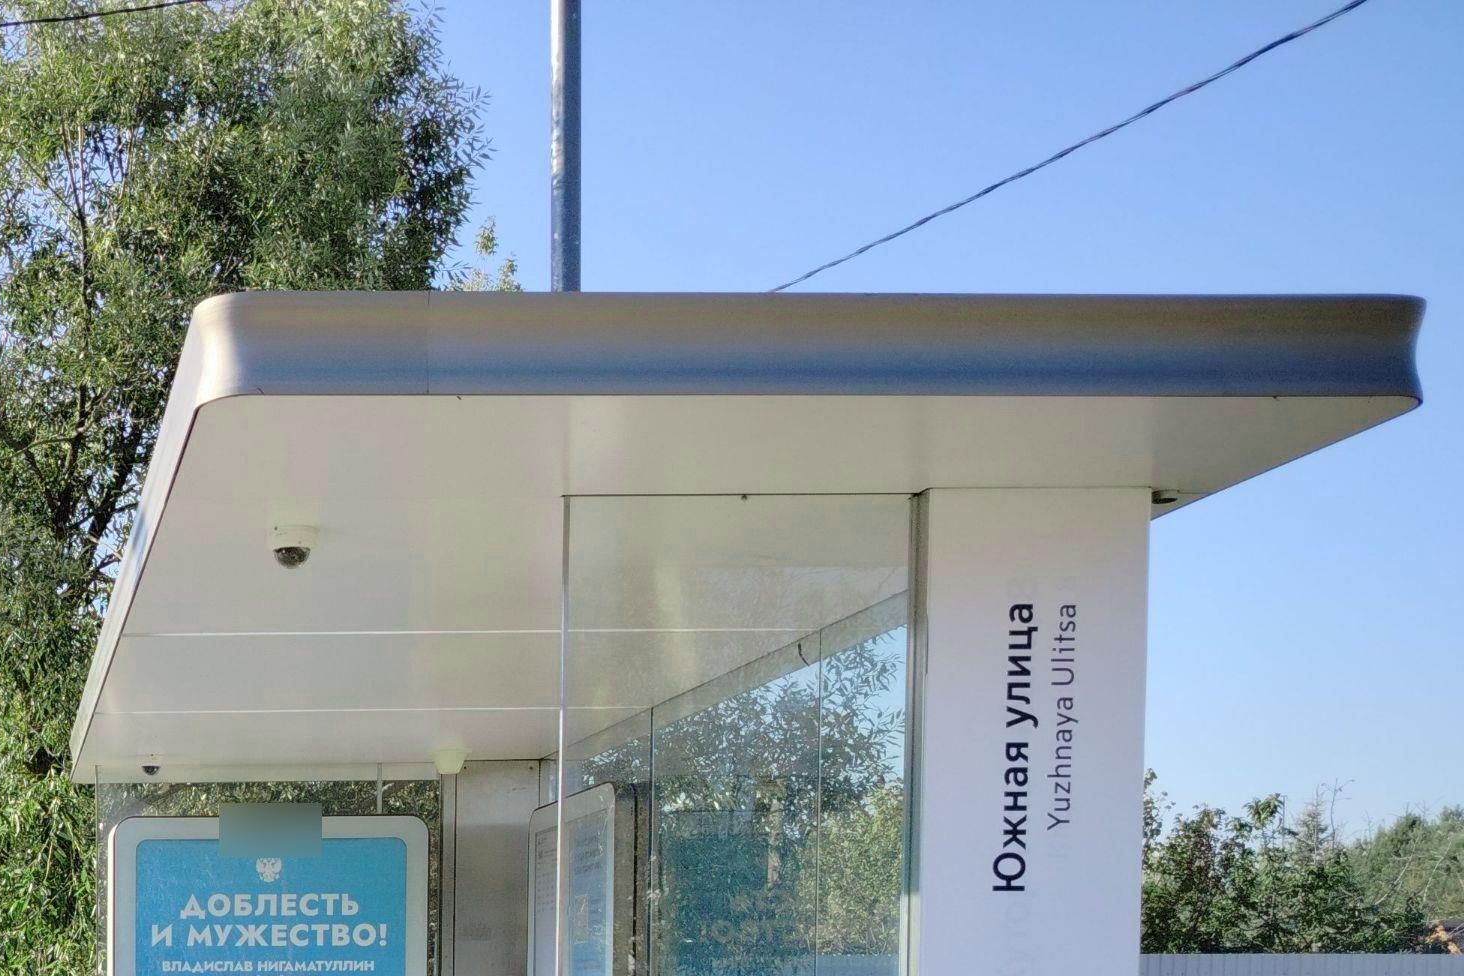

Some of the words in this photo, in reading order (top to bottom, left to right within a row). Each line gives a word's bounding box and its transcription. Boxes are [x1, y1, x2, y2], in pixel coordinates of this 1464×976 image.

[1006, 603, 1039, 729] улица
[1051, 603, 1077, 686] Ulitsa
[1047, 696, 1079, 831] Yuzhnaya
[992, 742, 1029, 891] Южная
[151, 924, 173, 947] И
[186, 923, 388, 947] МУЖЕСТВО!
[180, 893, 359, 919] ДОБЛЕСТЬ
[162, 960, 253, 973] ВЛАДИСЛАВ
[257, 960, 374, 972] НИГАМАТУЛЛИН
